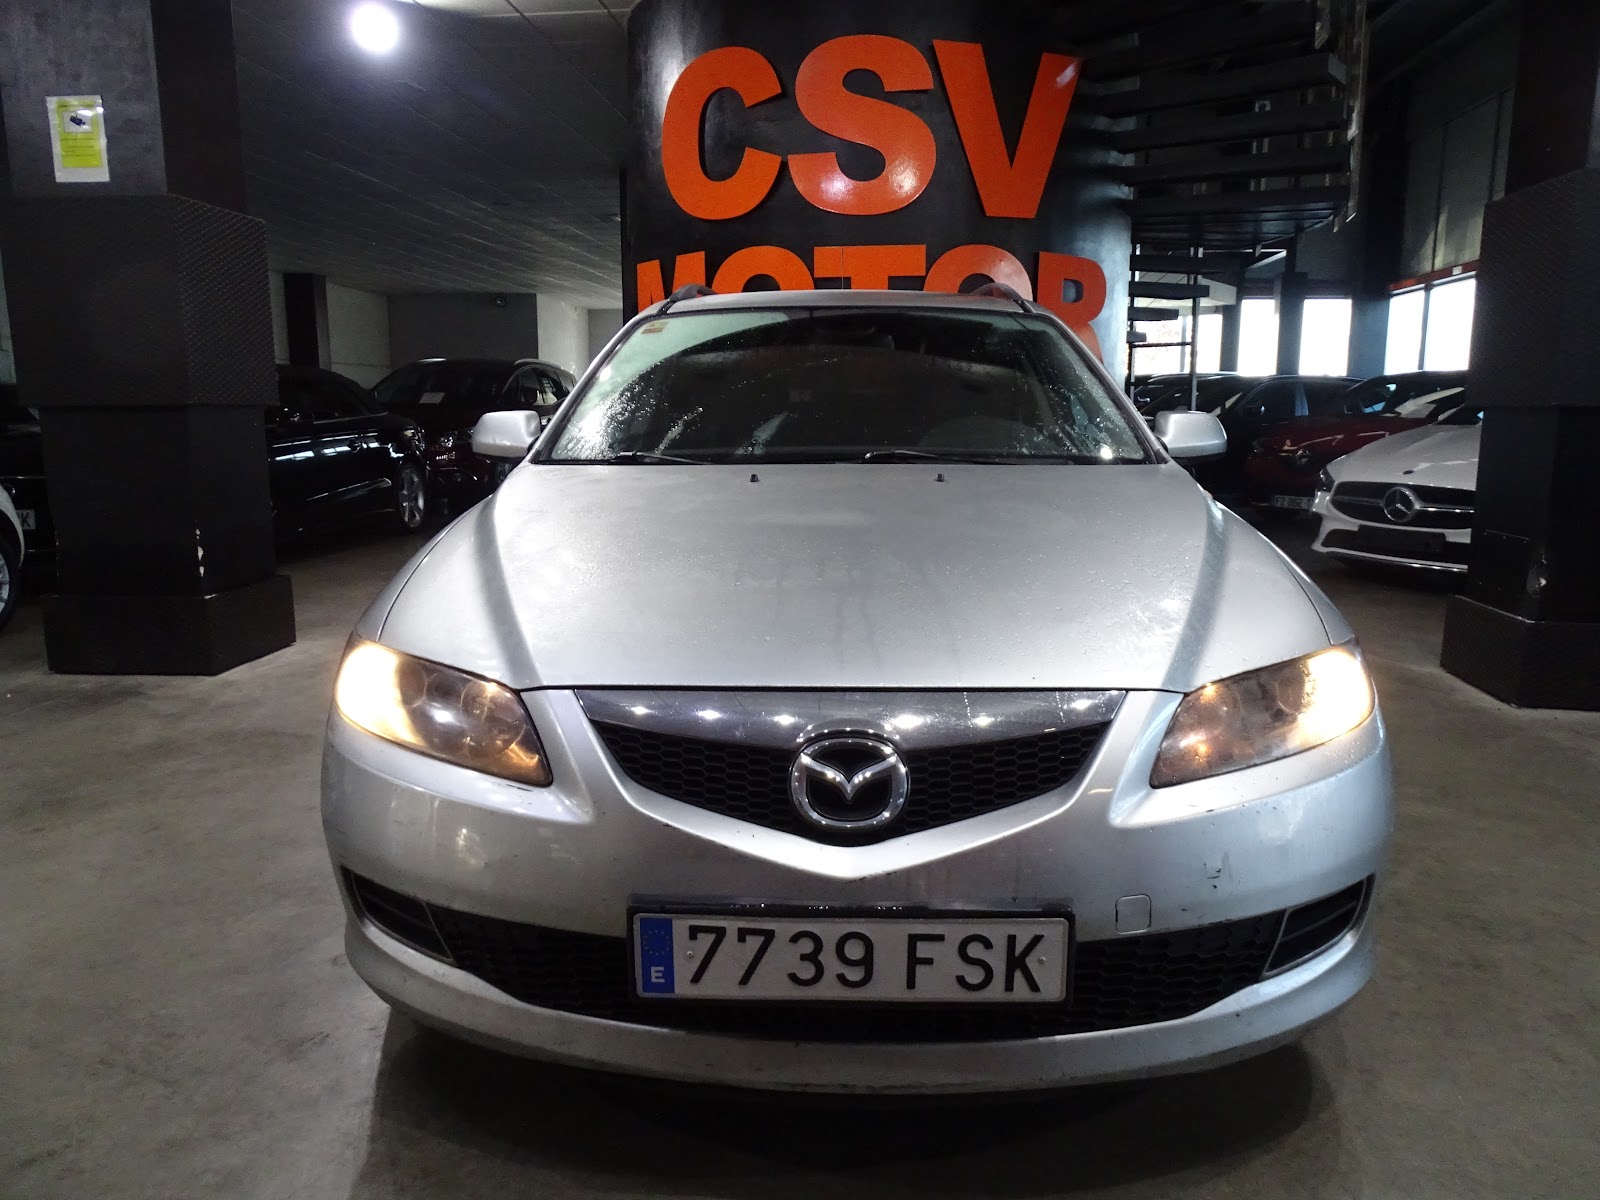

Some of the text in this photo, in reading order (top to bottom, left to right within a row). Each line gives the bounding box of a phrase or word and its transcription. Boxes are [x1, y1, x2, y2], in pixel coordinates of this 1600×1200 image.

[661, 34, 1080, 220] CSV
[650, 966, 665, 983] E
[688, 924, 1046, 993] 7739 FSK
